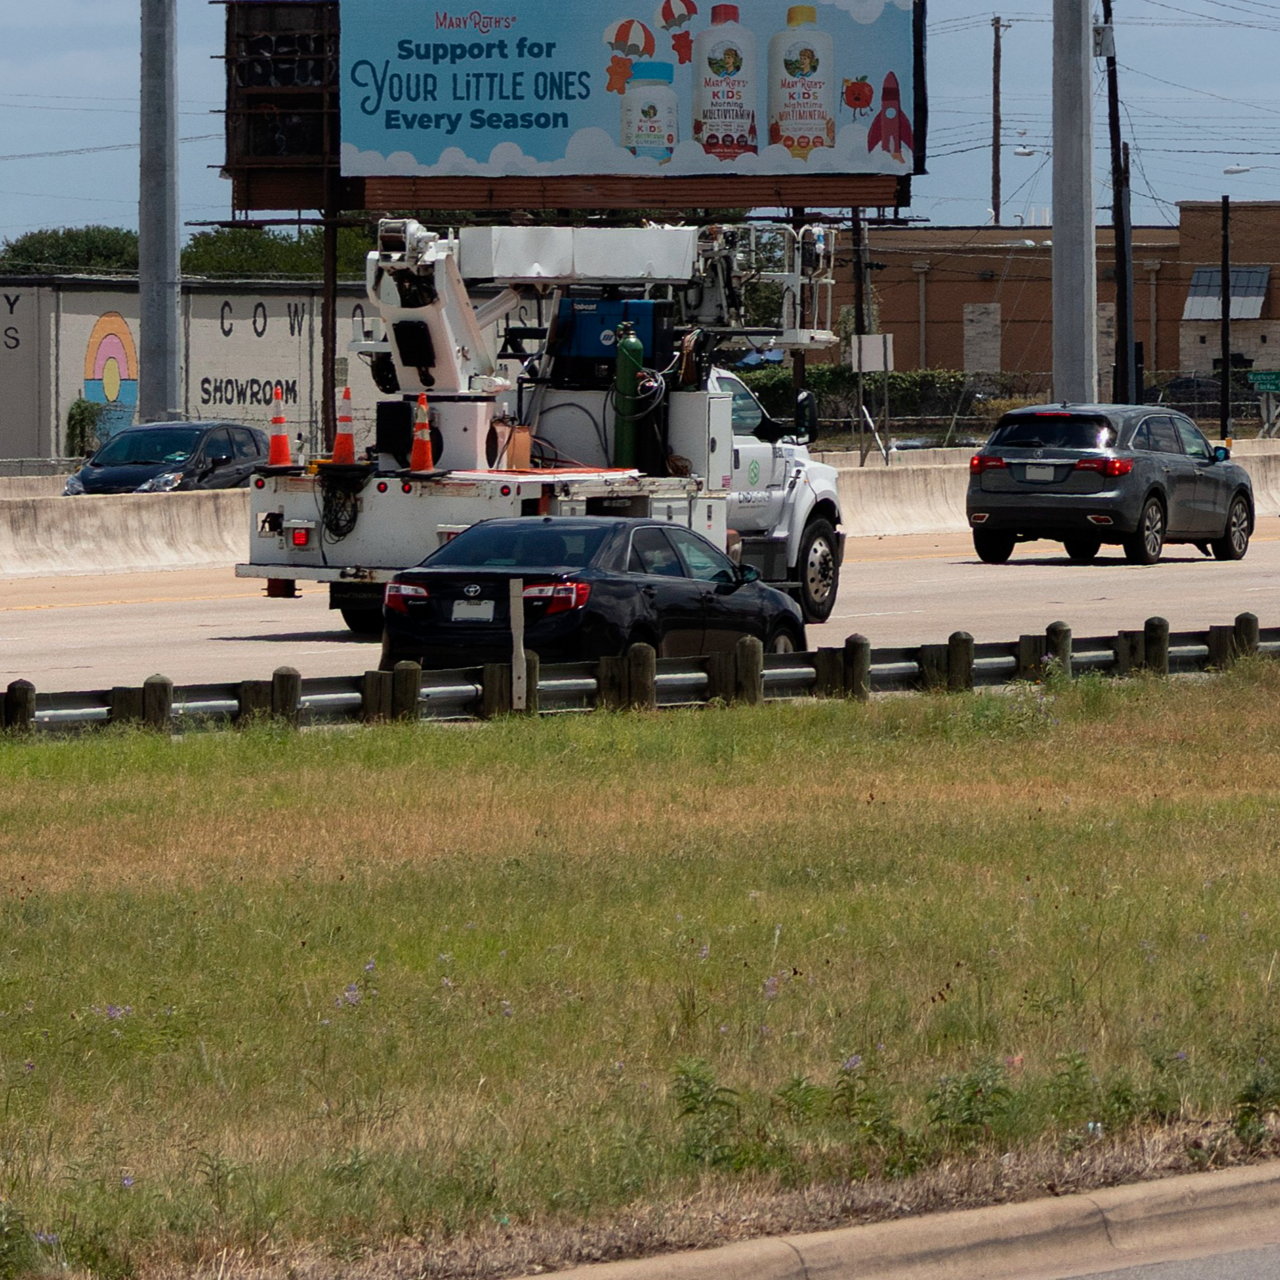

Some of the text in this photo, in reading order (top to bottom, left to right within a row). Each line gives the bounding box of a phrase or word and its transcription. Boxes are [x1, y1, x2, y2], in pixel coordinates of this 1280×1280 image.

[397, 37, 557, 65] Support for
[350, 59, 438, 116] YOUR
[534, 71, 591, 100] ONES
[712, 90, 742, 100] KIDS
[788, 91, 819, 100] KIDS
[384, 108, 569, 135] Every Season
[200, 376, 298, 406] SHOWROOM
